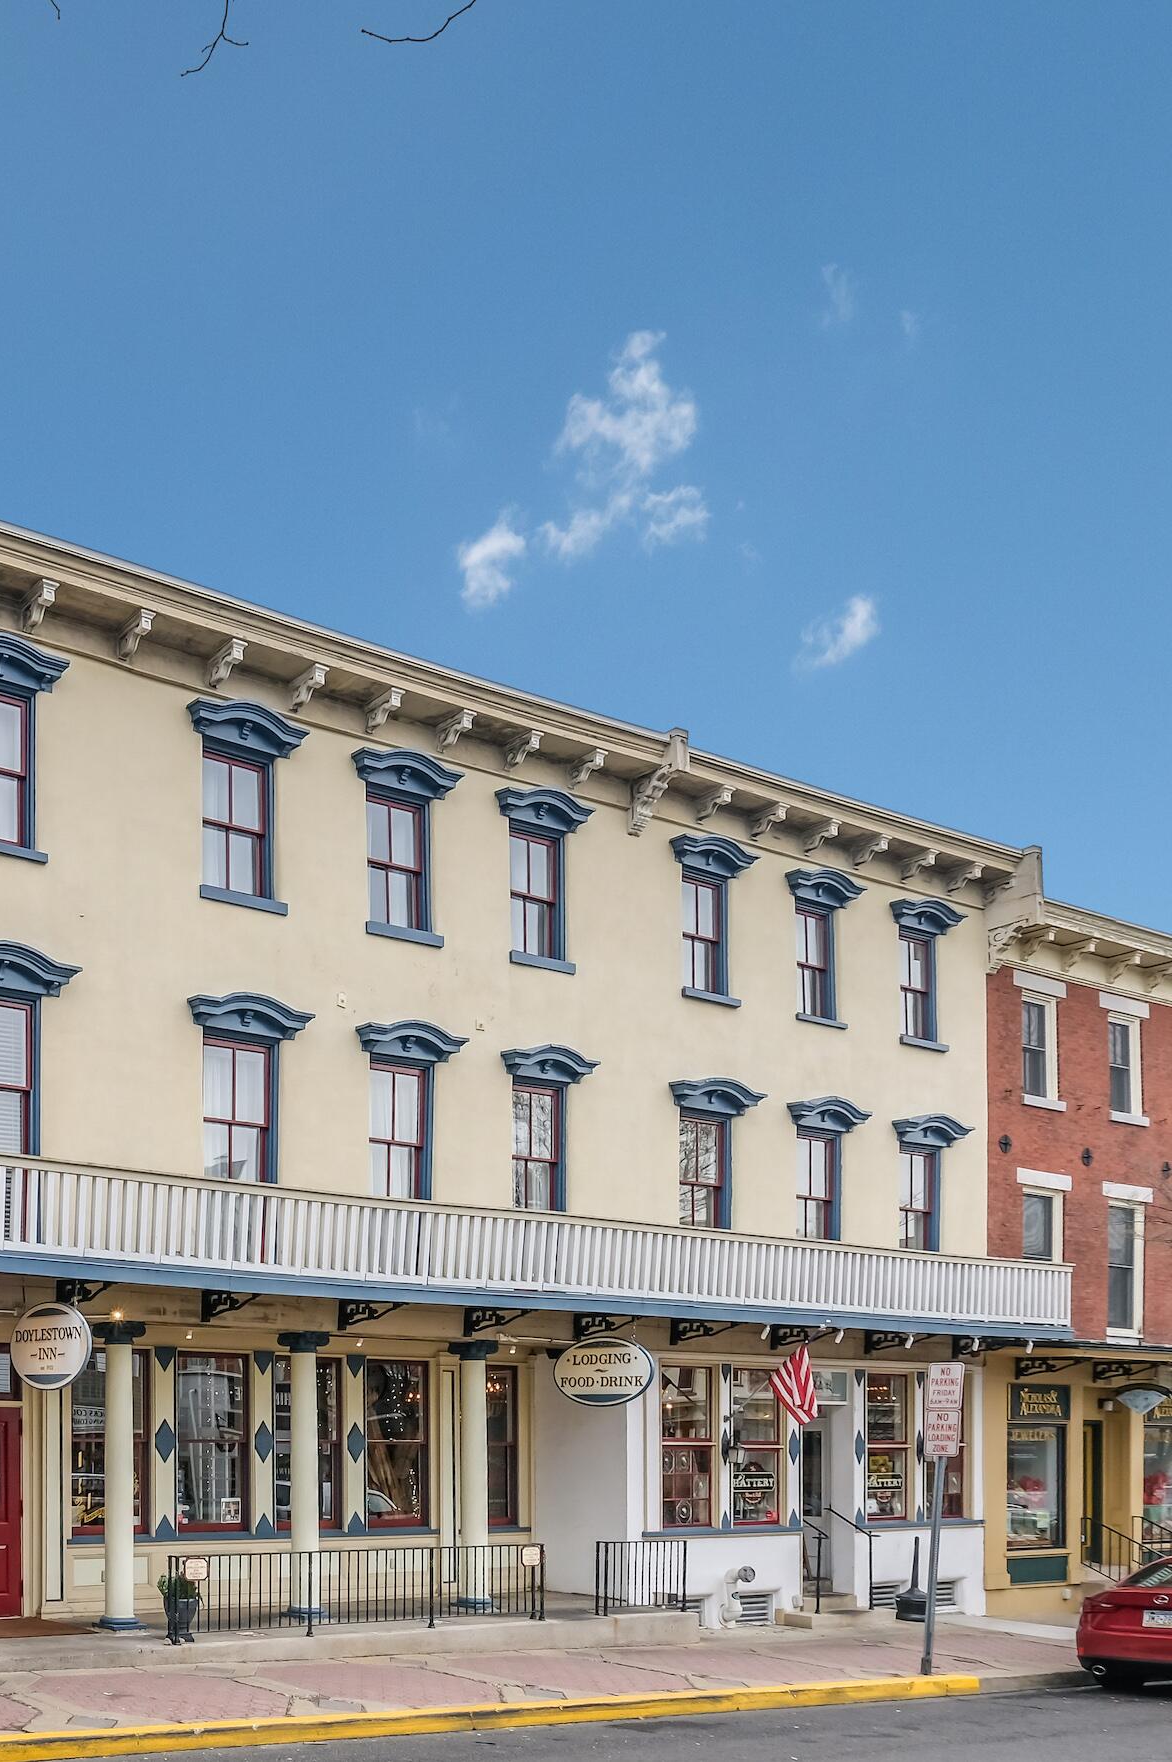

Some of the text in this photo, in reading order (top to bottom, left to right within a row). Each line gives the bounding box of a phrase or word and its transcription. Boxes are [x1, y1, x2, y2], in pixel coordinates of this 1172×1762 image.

[15, 1326, 82, 1343] DOYLESTOWN
[572, 1353, 631, 1366] LODGING
[940, 1367, 951, 1376] NO
[931, 1378, 959, 1387] PARKING
[932, 1389, 956, 1397] FRIDAY
[936, 1413, 949, 1422] NO
[928, 1423, 957, 1433] PARKING
[928, 1433, 956, 1442] LOADING
[932, 1444, 949, 1453] ZONE
